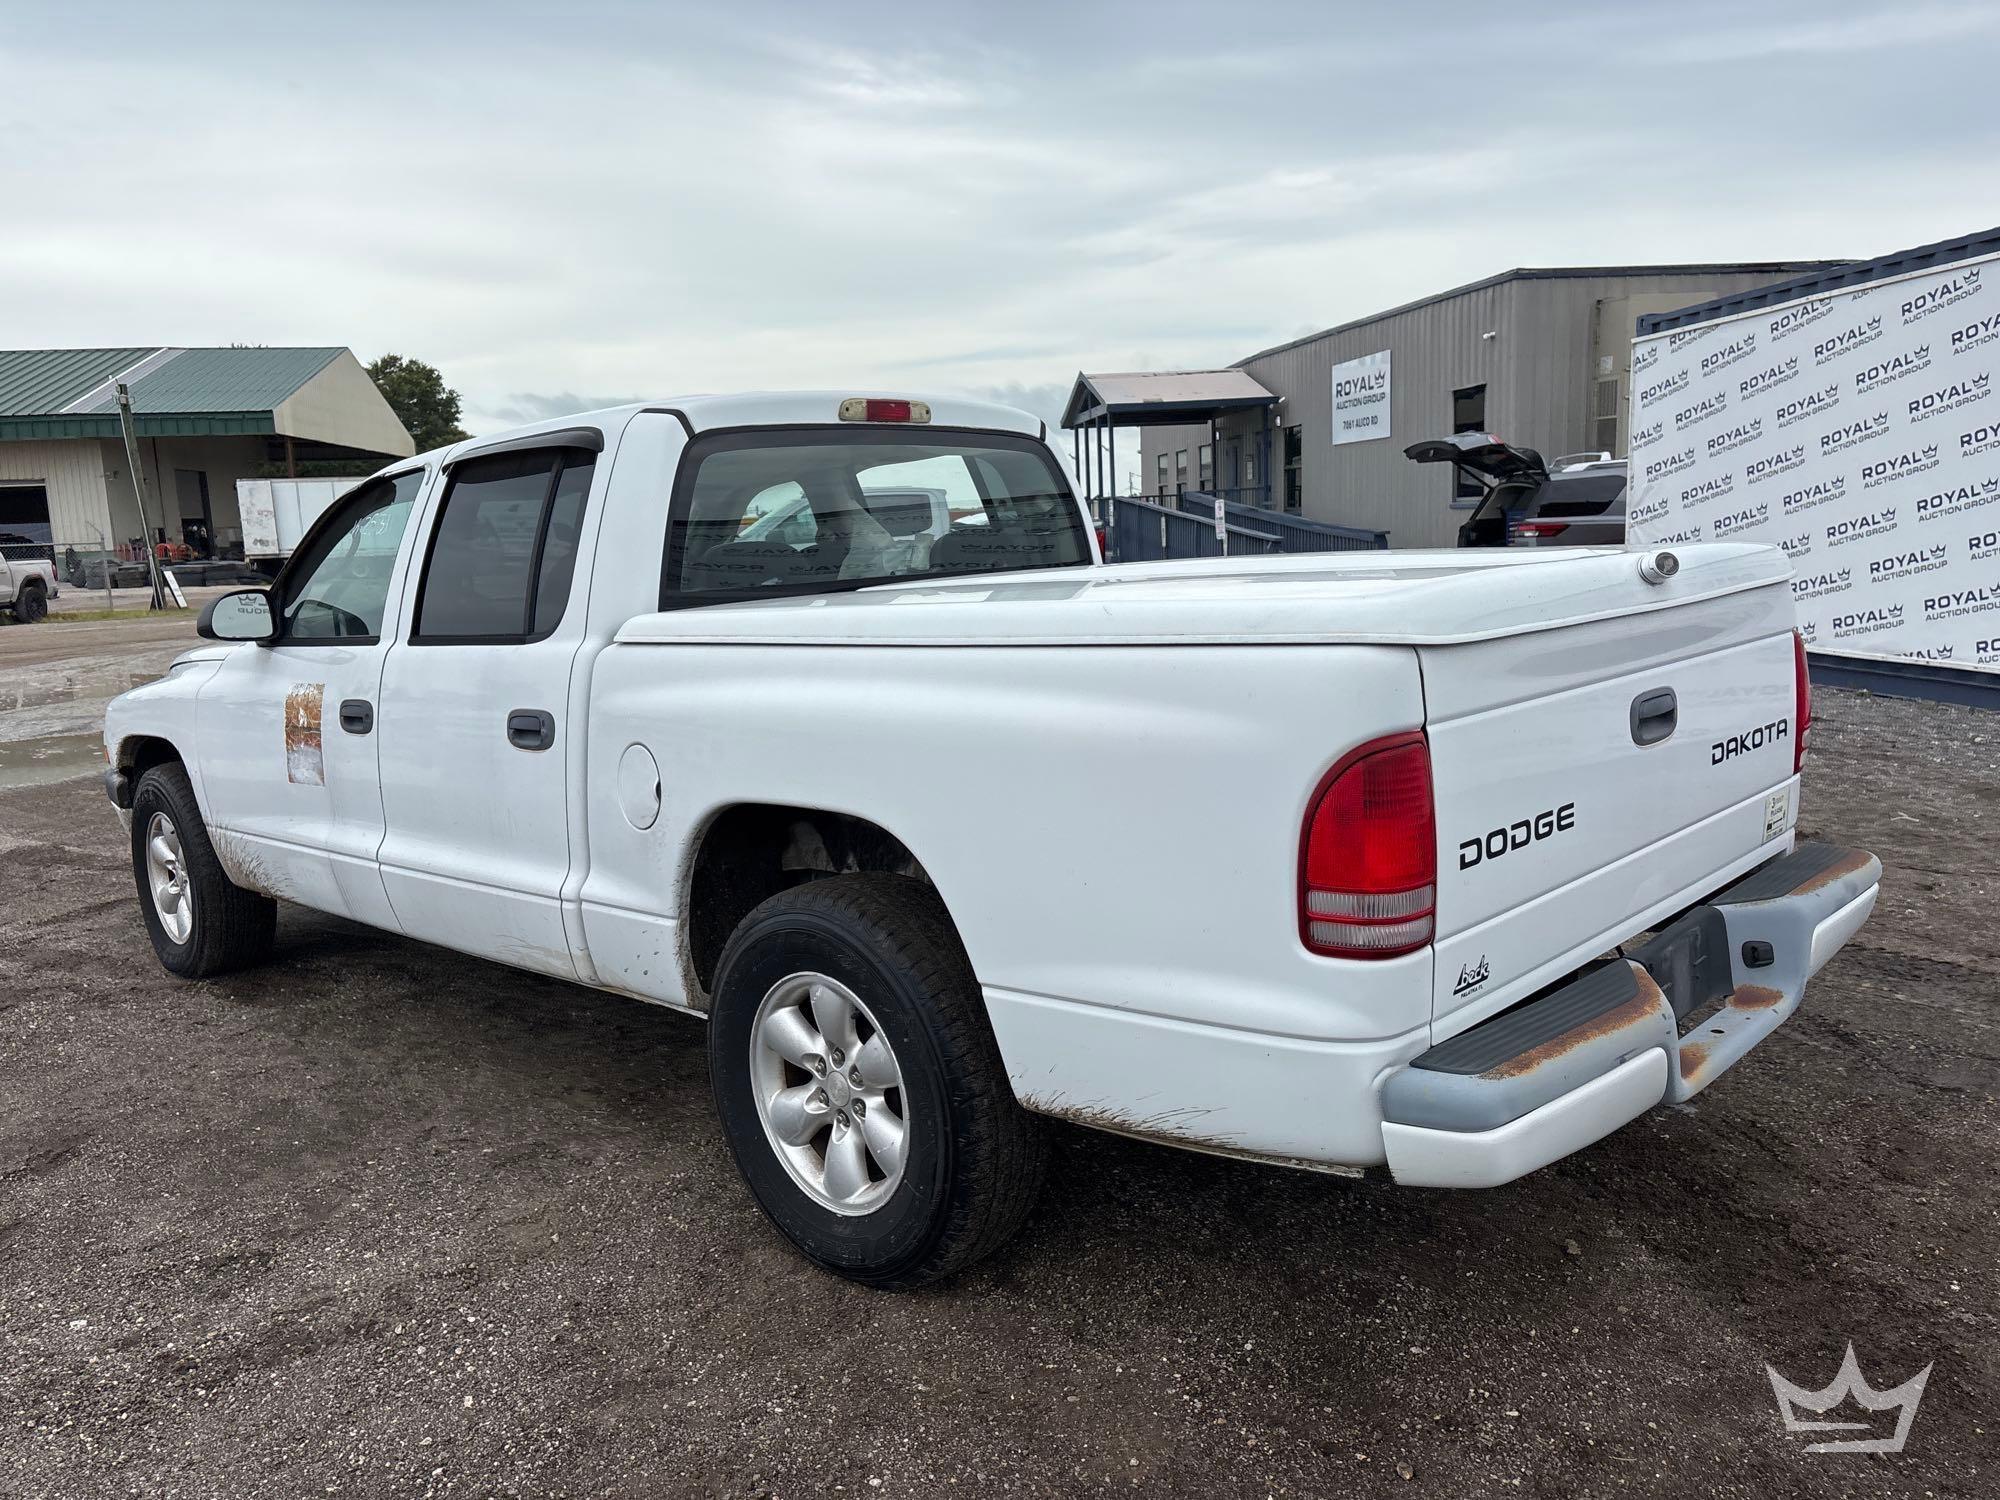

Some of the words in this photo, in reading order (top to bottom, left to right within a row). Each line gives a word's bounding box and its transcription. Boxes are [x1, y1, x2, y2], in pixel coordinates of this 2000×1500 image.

[1901, 279, 1963, 317] ROYAL
[1903, 302, 1945, 326] AUCTION
[1947, 284, 1982, 306] GROUP
[1770, 302, 1819, 334] ROYAL
[1771, 322, 1805, 342] AUCTION
[1805, 306, 1834, 325] GROUP
[1951, 313, 2000, 345] ROYA
[1814, 325, 1866, 358] ROYAL
[1816, 346, 1851, 366] AUCTION
[1852, 330, 1882, 349] GROUP
[1952, 331, 1999, 356] AUCTION
[1701, 341, 1744, 370] ROYAL
[1702, 360, 1731, 378] AUCTION
[1732, 346, 1756, 362] GROUP
[1740, 364, 1786, 394] ROYAL
[1856, 353, 1914, 386] ROYAL
[1857, 373, 1897, 395] AUCTION
[1898, 359, 1931, 378] GROUP
[1336, 375, 1374, 398] ROYAL
[1641, 376, 1679, 402] ROYAL
[1642, 393, 1668, 408] AUCTION
[1668, 380, 1689, 395] GROUP
[1741, 382, 1772, 401] AUCTION
[1773, 369, 1799, 387] GROUP
[1336, 398, 1362, 410] AUCTION
[1363, 392, 1386, 405] GROUP
[1675, 398, 1716, 424] ROYAL
[1777, 392, 1825, 421] ROYAL
[1908, 382, 1973, 415] ROYAL
[1910, 402, 1954, 424] AUCTION
[1955, 388, 1991, 408] GROUP
[1371, 415, 1378, 425] RD
[1676, 415, 1704, 432] AUCTION
[1704, 403, 1727, 419] GROUP
[1778, 410, 1811, 429] AUCTION
[1812, 397, 1840, 415] GROUP
[1633, 428, 1653, 444] YAL
[1707, 425, 1750, 451] ROYAL
[1709, 443, 1738, 458] AUCTION
[1738, 431, 1763, 446] GROUP
[1821, 419, 1873, 448] ROYAL
[1822, 438, 1857, 457] AUCTION
[1858, 426, 1890, 443] GROUP
[1960, 422, 2000, 448] ROY
[1962, 440, 2000, 459] AUCTIO
[1646, 453, 1685, 477] ROYAL
[1647, 468, 1673, 483] AUCTION
[1674, 459, 1696, 473] GROUP
[1746, 451, 1792, 477] ROYAL
[1747, 468, 1779, 485] AUCTION
[1779, 458, 1806, 473] GROUP
[1862, 451, 1922, 480] ROYAL
[1863, 471, 1905, 490] AUCTION
[1906, 459, 1940, 476] GROUP
[1681, 479, 1722, 502] ROYAL
[1683, 495, 1710, 510] AUCTION
[1710, 485, 1734, 500] GROUP
[1783, 482, 1832, 508] ROYAL
[1784, 499, 1817, 516] AUCTION
[1818, 490, 1846, 505] GROUP
[1917, 484, 1981, 513] ROYAL
[1631, 503, 1659, 521] OYAL
[1714, 508, 1757, 532] ROYAL
[1918, 504, 1962, 523] AUCTION
[1963, 493, 2000, 510] GROUP
[1715, 525, 1745, 538] AUCTION
[1745, 516, 1769, 530] GROUP
[1826, 514, 1881, 539] ROYAL
[1828, 532, 1865, 548] AUCTION
[1865, 522, 1898, 537] GROUP
[1870, 550, 1930, 574] ROYAL
[1871, 568, 1912, 583] AUCTION
[1913, 559, 1948, 575] GROUP
[1794, 589, 1823, 602] UCTION
[1824, 582, 1852, 595] GROUP
[1924, 588, 1990, 611] ROYAL
[1833, 608, 1888, 630] ROYAL
[1925, 607, 1970, 621] AUCTION
[1972, 601, 2000, 613] GROU
[1834, 624, 1871, 638] AUCTION
[1873, 619, 1905, 632] GROUP
[1712, 718, 1788, 766] DAKOTA
[1459, 802, 1575, 871] DODGE
